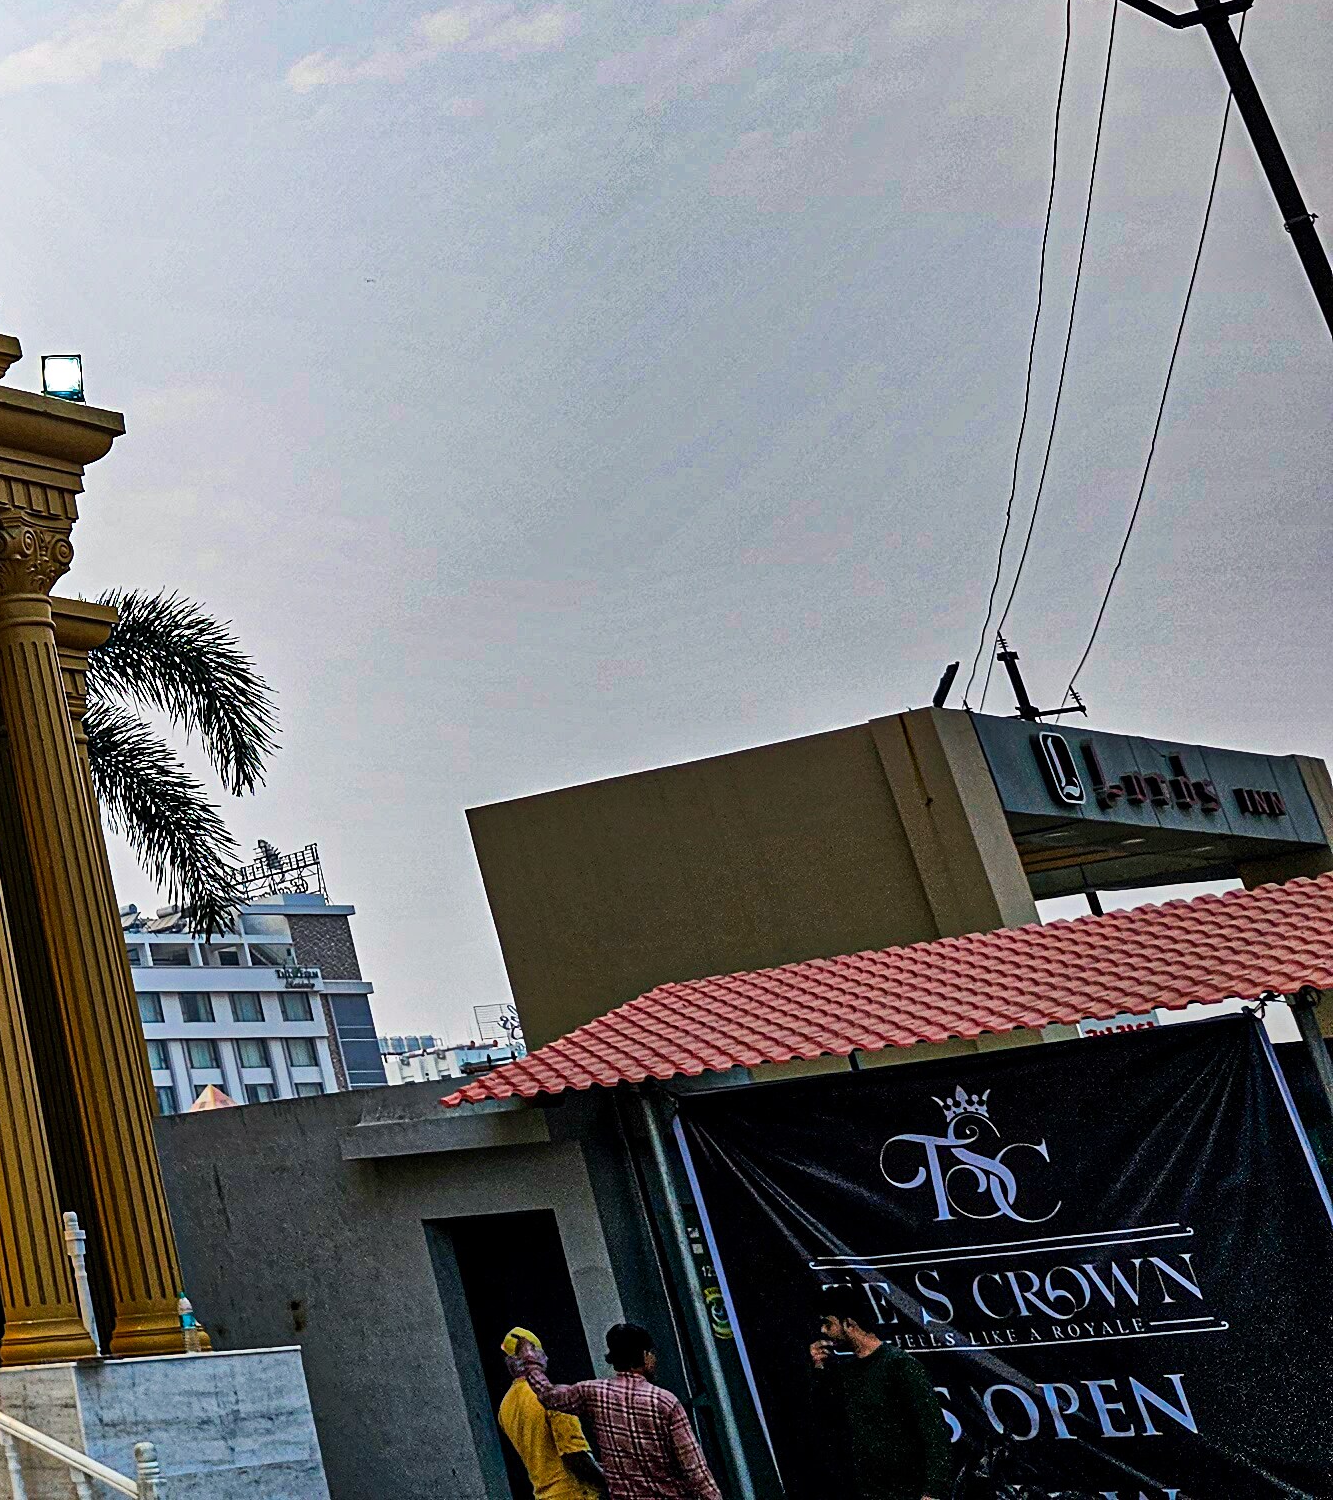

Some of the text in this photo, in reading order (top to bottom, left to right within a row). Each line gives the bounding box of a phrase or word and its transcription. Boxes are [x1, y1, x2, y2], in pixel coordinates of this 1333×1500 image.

[1233, 787, 1286, 817] INN
[915, 1269, 955, 1325] S
[973, 1253, 1204, 1321] CROWN
[894, 1318, 1146, 1349] FEELS LIKE A ROYALE
[983, 1373, 1199, 1442] OPEN
